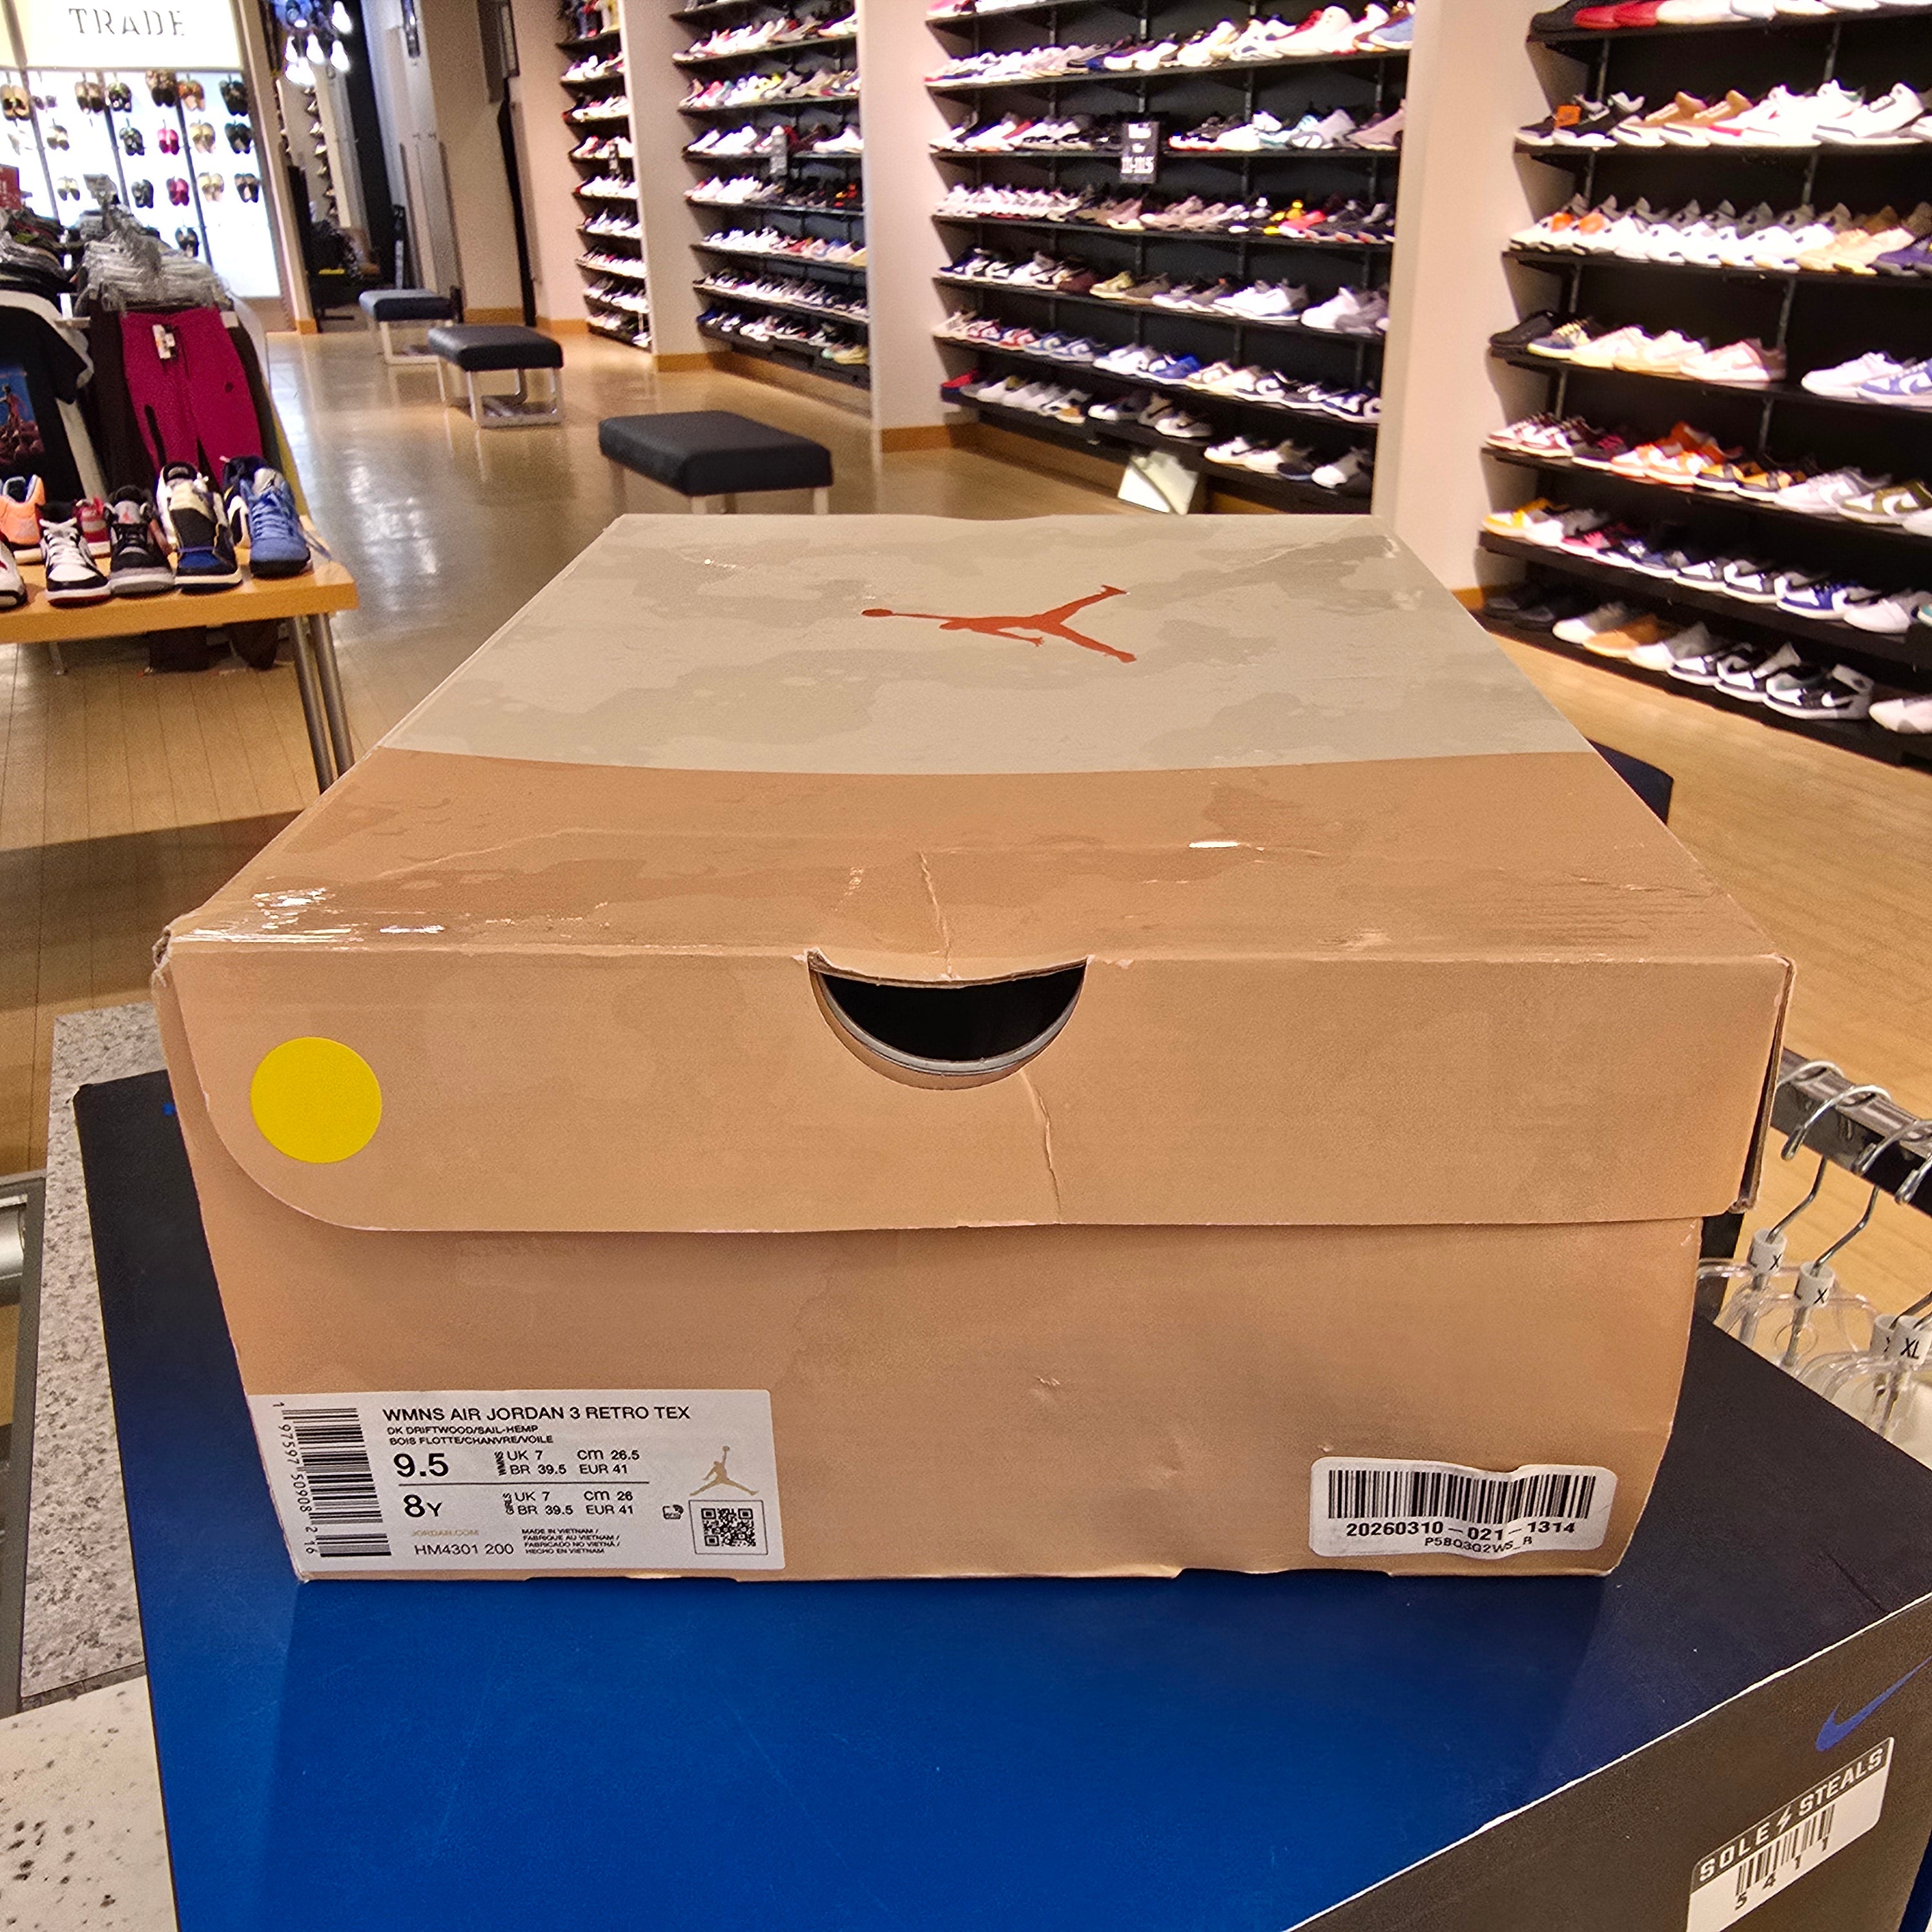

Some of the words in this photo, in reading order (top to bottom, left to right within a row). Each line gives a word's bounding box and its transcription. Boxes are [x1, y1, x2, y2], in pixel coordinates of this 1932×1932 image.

[68, 8, 185, 36] TRADE
[1900, 1337, 1920, 1359] XL
[382, 1408, 446, 1421] WMNS
[450, 1408, 482, 1421] AIR
[486, 1406, 564, 1421] JORDAN
[569, 1406, 581, 1419] 3
[585, 1406, 650, 1419] RETRO
[653, 1405, 691, 1419] TEX
[389, 1437, 417, 1446] BOIS
[506, 1450, 529, 1461] UK
[535, 1450, 544, 1461] 7
[610, 1449, 641, 1461] 26.5
[278, 1423, 300, 1465] 97597
[291, 1473, 313, 1514] 50908
[393, 1452, 449, 1477] 9.5
[509, 1464, 531, 1475] BR
[537, 1463, 567, 1475] 39.5
[579, 1463, 609, 1474] EUR
[612, 1463, 628, 1474] 41
[514, 1491, 536, 1502] UK
[542, 1491, 551, 1502] 7
[617, 1490, 633, 1501] 26
[517, 1505, 538, 1516] BR
[544, 1504, 573, 1515] 39.5
[586, 1505, 615, 1515] EUR
[619, 1505, 633, 1515] 41
[414, 1543, 478, 1555] HM4301
[484, 1543, 514, 1555] 200
[1699, 1822, 1770, 1882] SOLE
[1798, 1747, 1884, 1816] STEALS
